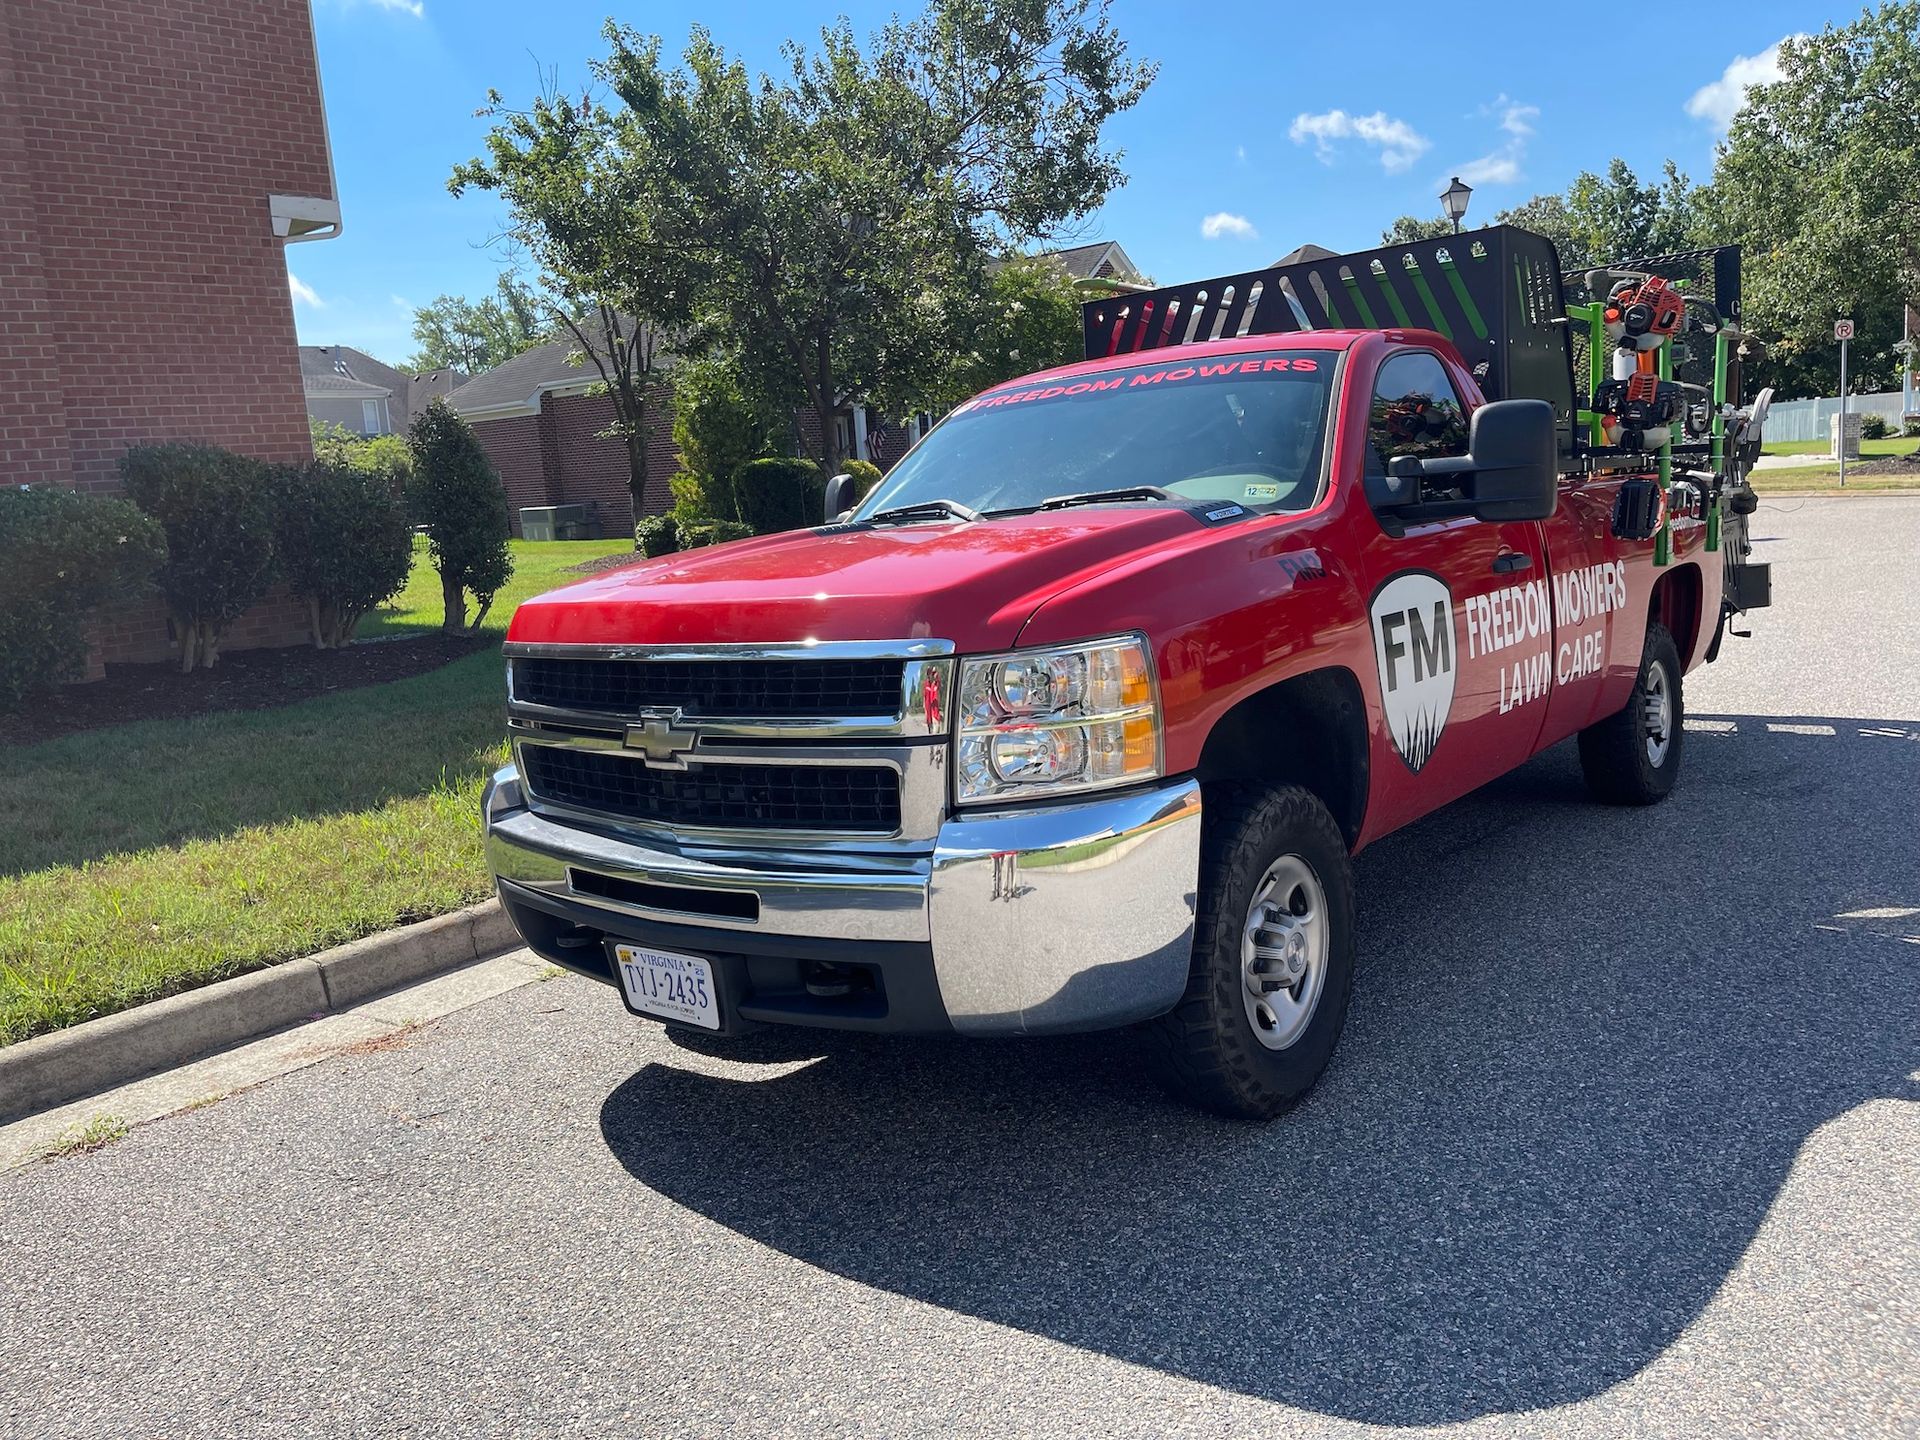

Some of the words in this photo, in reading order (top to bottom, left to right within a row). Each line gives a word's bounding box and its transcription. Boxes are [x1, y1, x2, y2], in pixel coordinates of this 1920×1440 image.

[971, 378, 1125, 411] FREEDOM
[1129, 358, 1318, 387] MOWERS
[1248, 487, 1258, 496] 12
[1553, 559, 1626, 628] MOWERS
[1381, 600, 1451, 693] FM
[1557, 631, 1603, 686] CARE
[625, 964, 708, 1009] TYJ-2435
[640, 953, 686, 972] VIRGINIA
